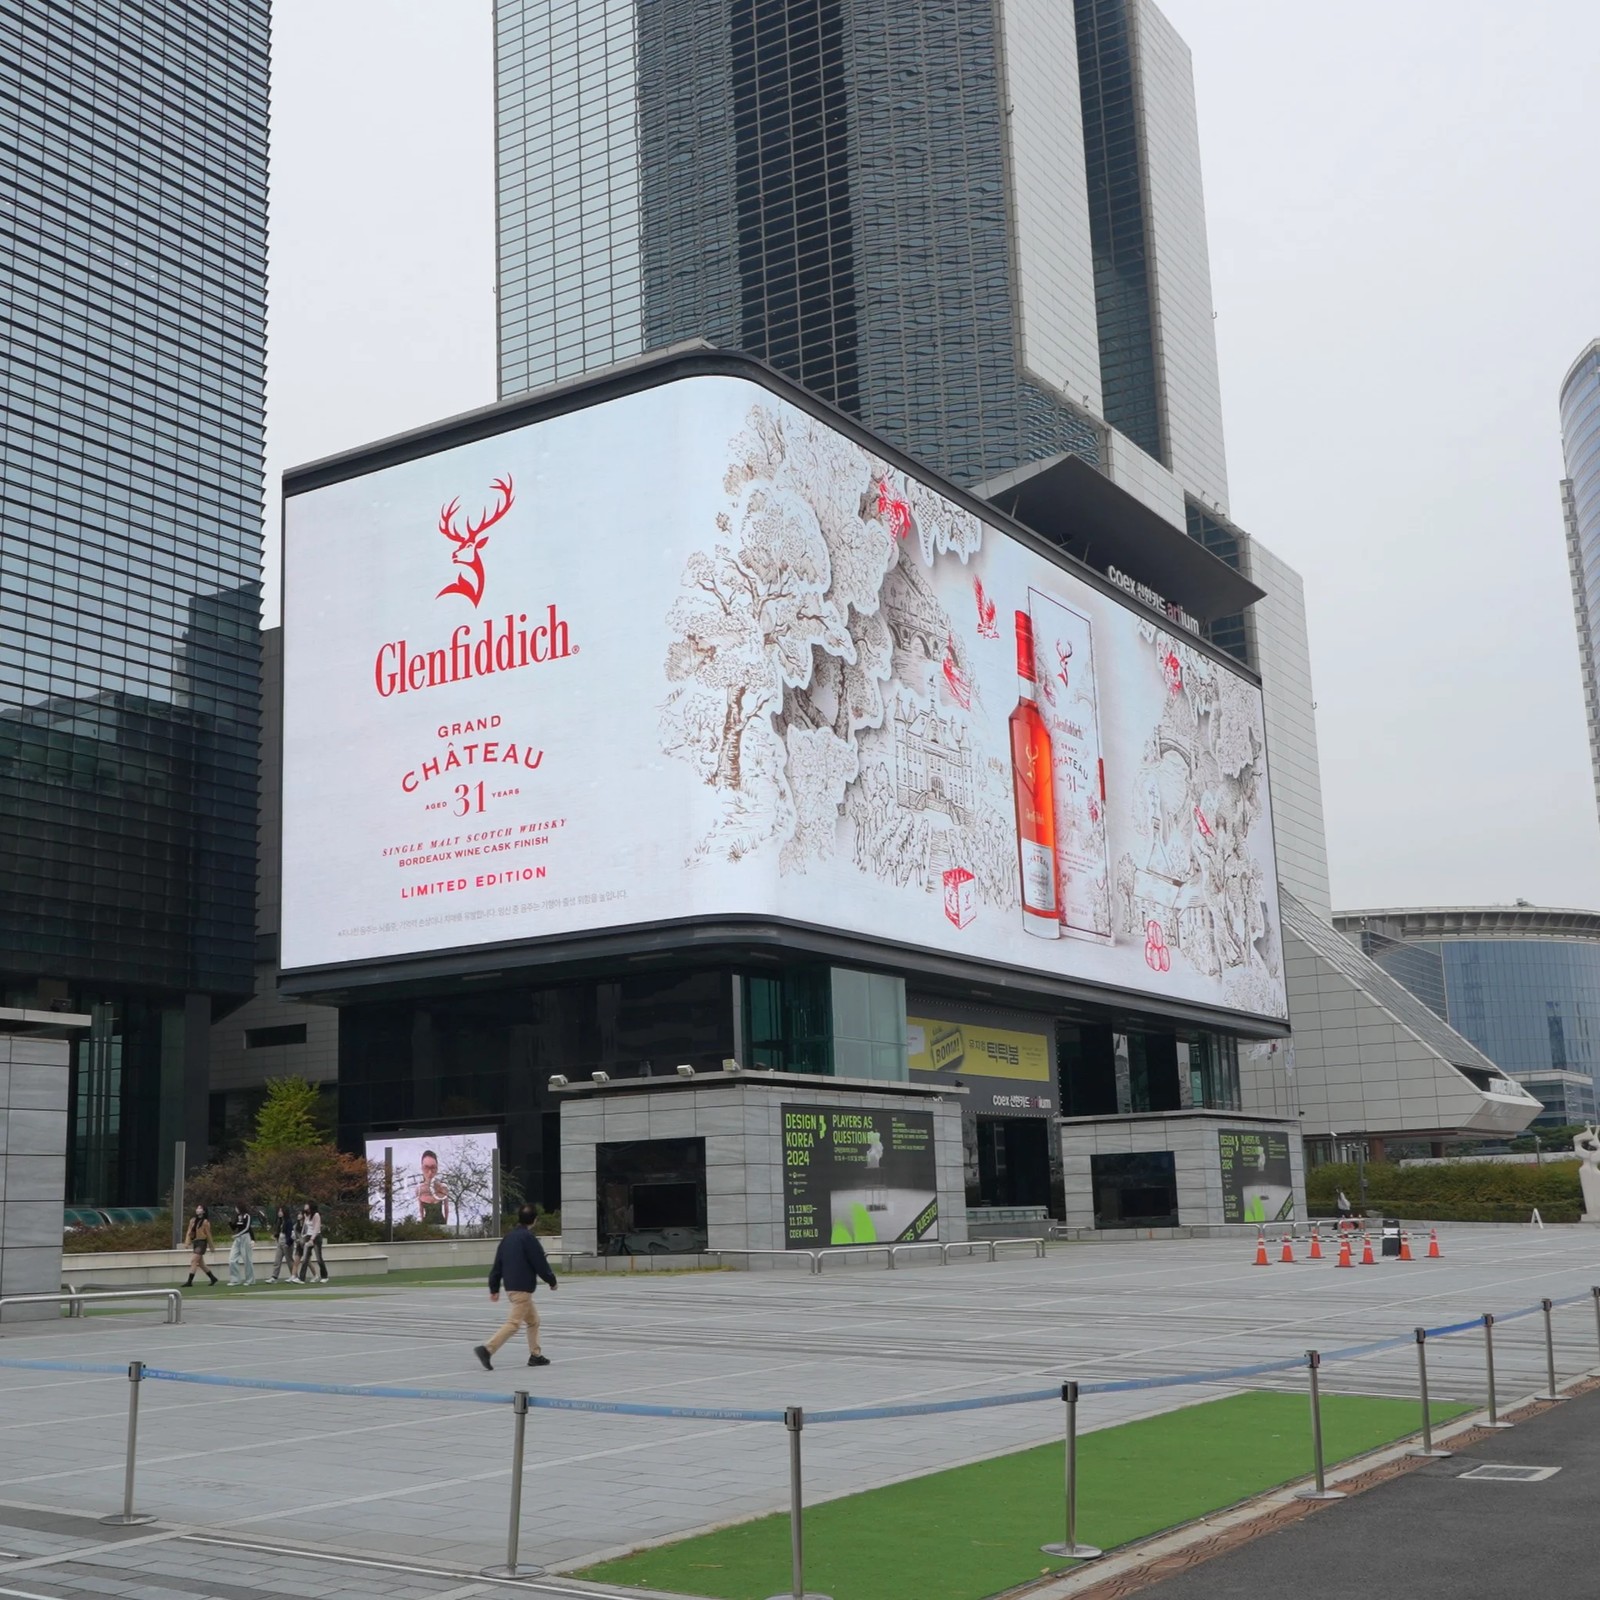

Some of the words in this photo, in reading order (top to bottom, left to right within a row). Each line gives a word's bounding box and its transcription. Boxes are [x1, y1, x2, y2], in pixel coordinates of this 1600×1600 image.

[1108, 564, 1136, 595] coex
[375, 604, 572, 697] Glenfiddich
[438, 715, 501, 738] GRAND
[402, 742, 544, 793] CHÂTEAU
[425, 801, 448, 811] AGED
[453, 780, 487, 818] 31
[492, 788, 520, 798] YEARS
[382, 842, 424, 857] SINGLE
[430, 836, 461, 849] MALT
[466, 827, 513, 843] SCOTCH
[519, 818, 567, 834] WHISKY
[399, 851, 452, 868] BORDEAUX
[455, 846, 481, 858] WINE
[484, 841, 511, 854] CASK
[514, 836, 549, 849] FINISH
[401, 879, 468, 899] LIMITED
[475, 866, 546, 888] EDITION
[987, 1041, 1019, 1065] 틱틱붐
[993, 1095, 1010, 1106] coex
[786, 1113, 817, 1130] DESIGN
[832, 1114, 862, 1129] PLAYERS
[863, 1116, 873, 1129] AS
[786, 1132, 815, 1148] KOREA
[787, 1150, 810, 1166] 2024
